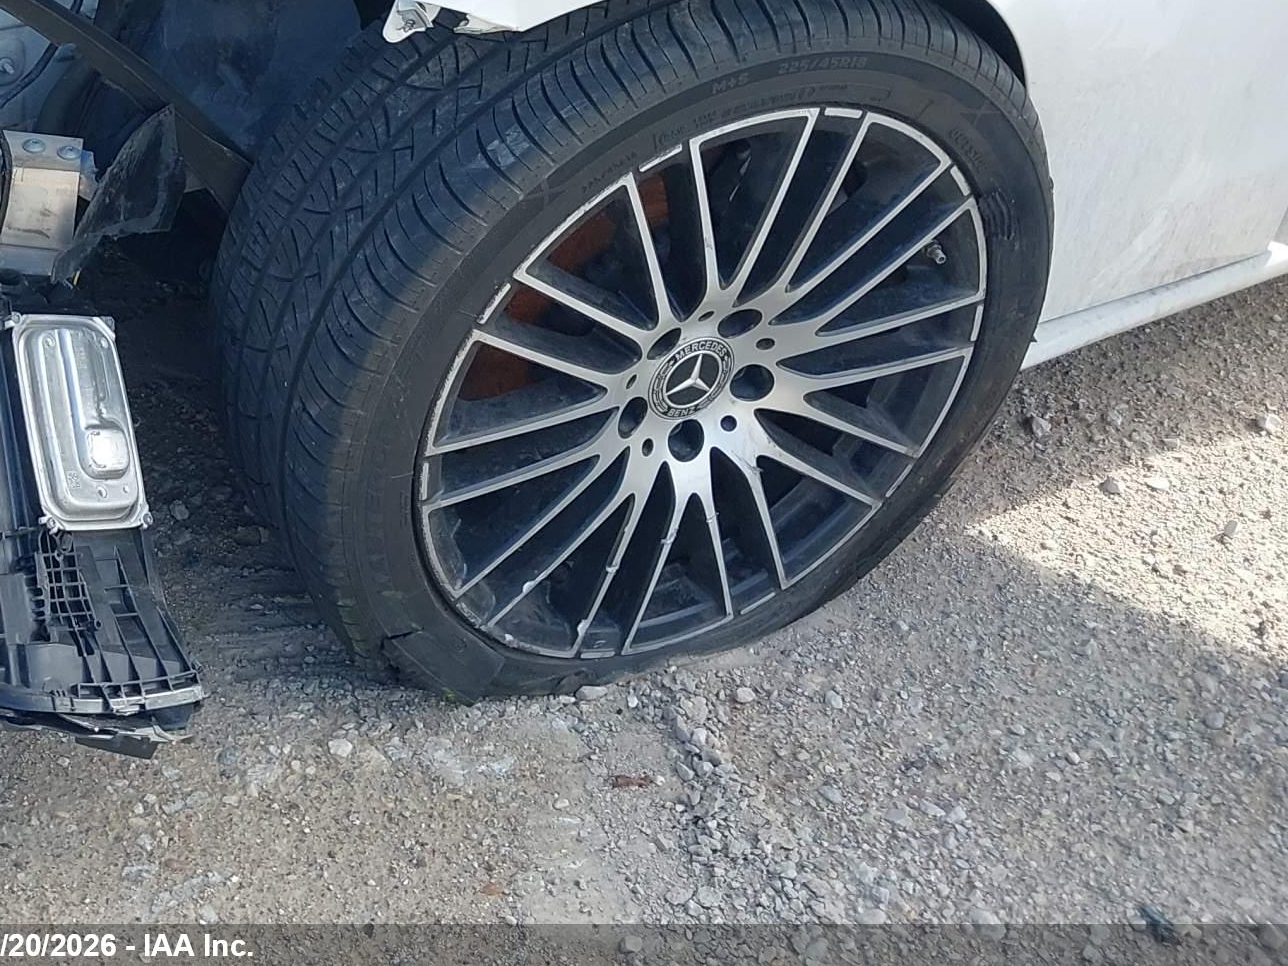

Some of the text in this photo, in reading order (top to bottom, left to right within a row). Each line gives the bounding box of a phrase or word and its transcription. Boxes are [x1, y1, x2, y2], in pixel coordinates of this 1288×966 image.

[711, 72, 750, 94] M+S
[675, 341, 727, 361] MERCEDES
[667, 406, 697, 417] BENZ
